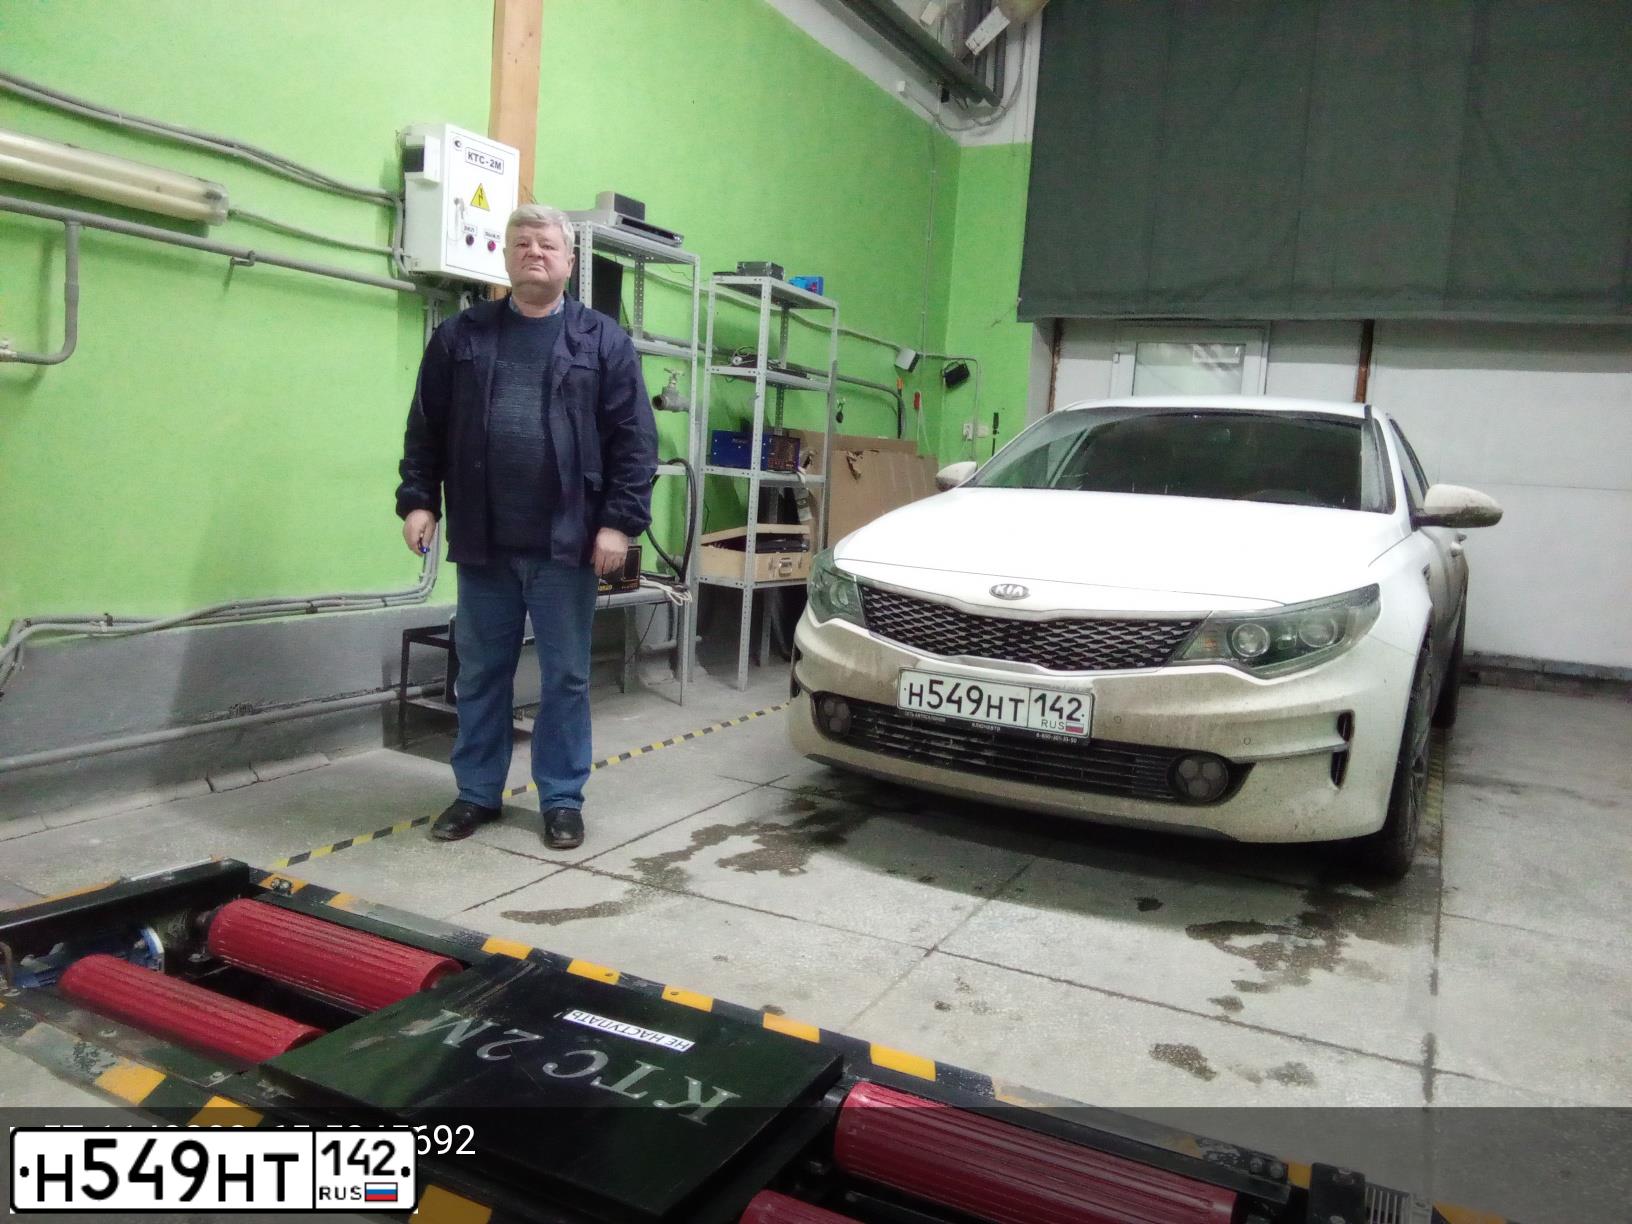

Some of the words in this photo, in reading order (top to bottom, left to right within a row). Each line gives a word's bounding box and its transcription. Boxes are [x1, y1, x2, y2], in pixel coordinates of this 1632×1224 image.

[468, 151, 501, 170] КТС-2М
[995, 584, 1024, 597] KIA
[909, 679, 1025, 722] Н549НТ
[1034, 692, 1083, 722] 142
[1041, 719, 1065, 730] RUS
[571, 1011, 666, 1042] НАСТУПАТЬ
[665, 1038, 690, 1050] НЕ
